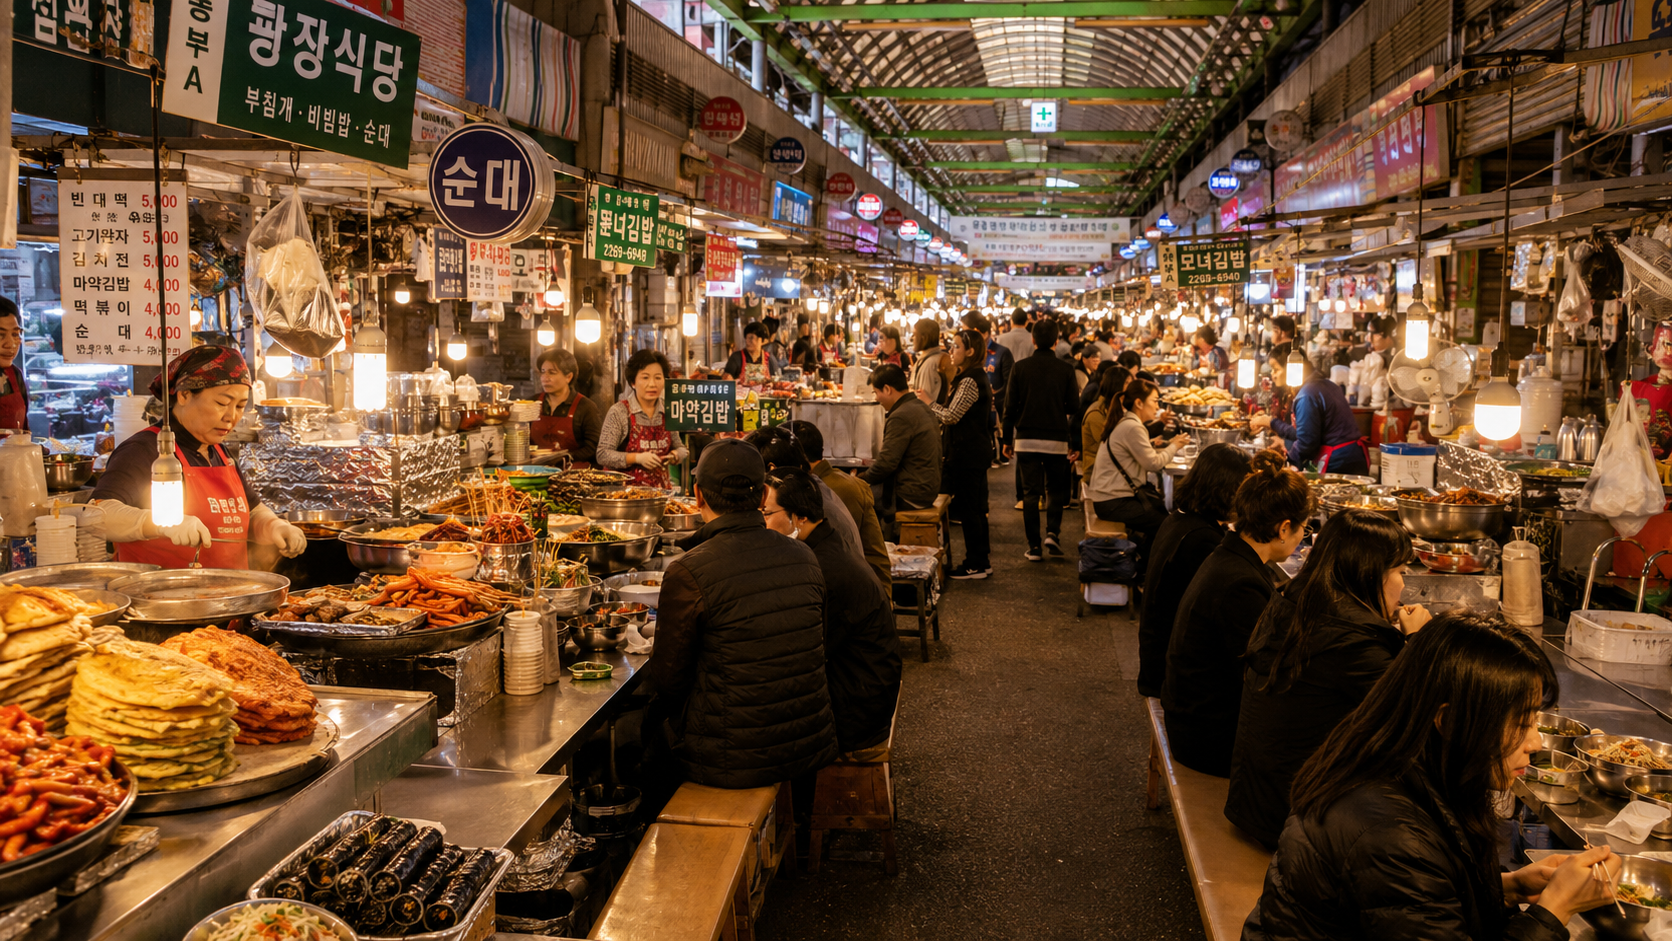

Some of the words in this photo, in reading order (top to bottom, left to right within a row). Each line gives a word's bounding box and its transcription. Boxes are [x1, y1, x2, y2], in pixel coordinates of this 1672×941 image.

[245, 86, 293, 123] 부침개
[306, 104, 351, 138] 비빔밥
[363, 119, 391, 149] 순대
[442, 156, 521, 211] 순대
[74, 275, 130, 291] 마약김밥
